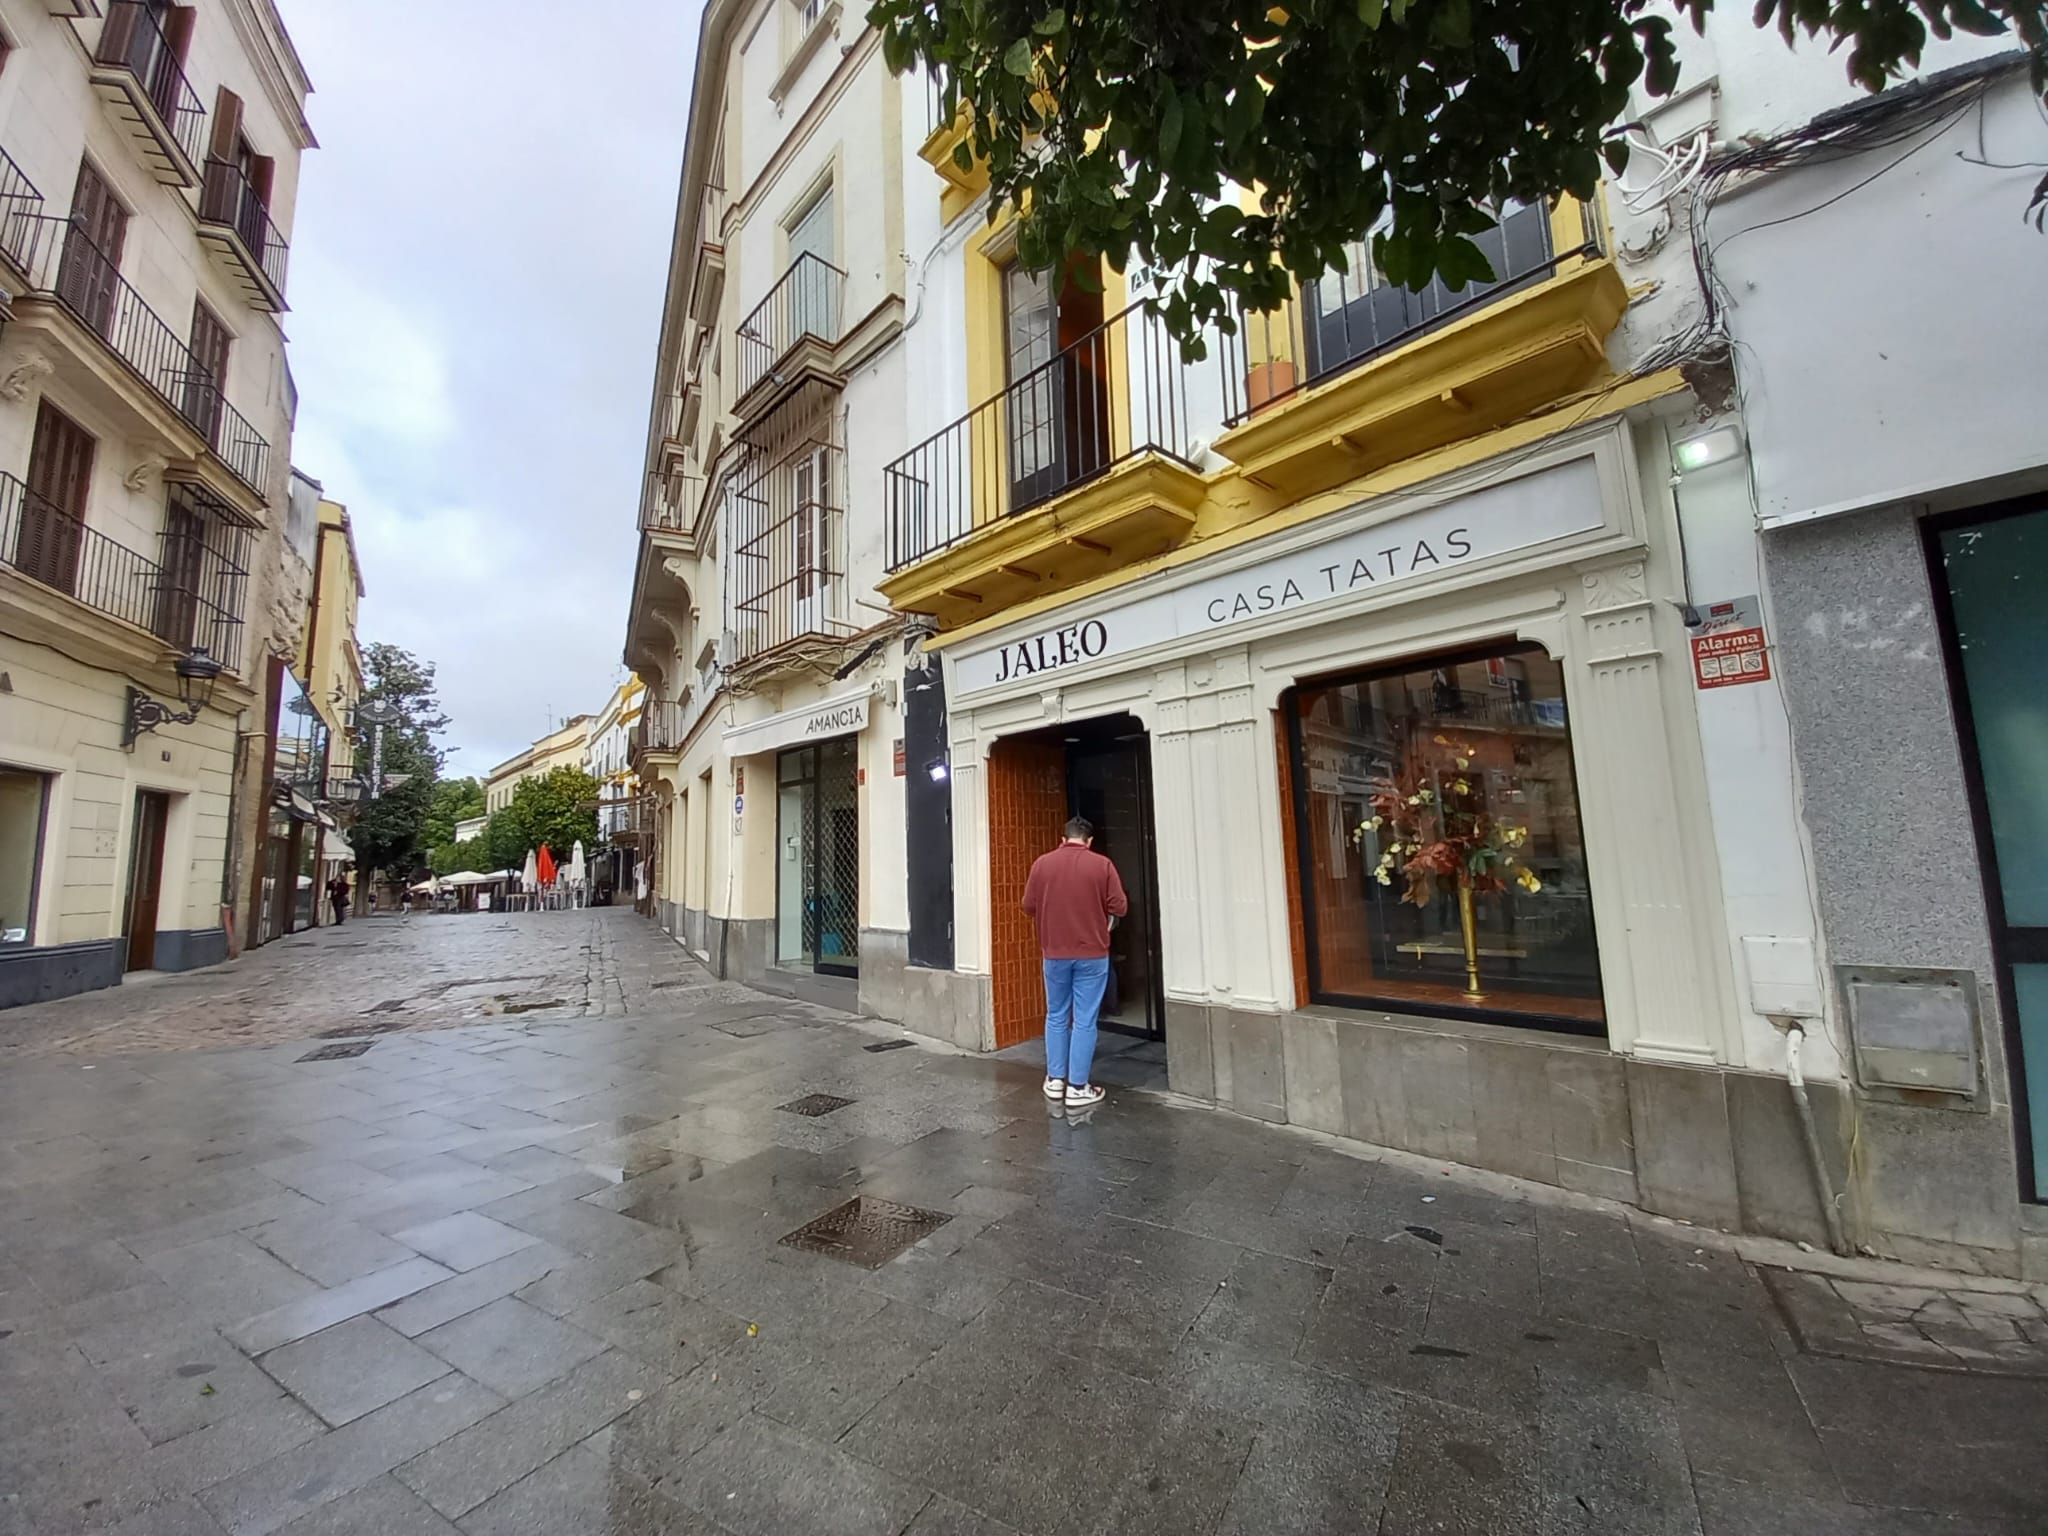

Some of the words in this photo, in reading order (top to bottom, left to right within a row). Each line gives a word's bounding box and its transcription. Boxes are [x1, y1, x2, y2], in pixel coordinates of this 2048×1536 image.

[1207, 578, 1304, 623] CASA
[1319, 528, 1472, 593] TATAS
[995, 619, 1108, 682] JALEO
[1697, 633, 1759, 653] Alarma
[805, 705, 864, 735] AMANCIA
